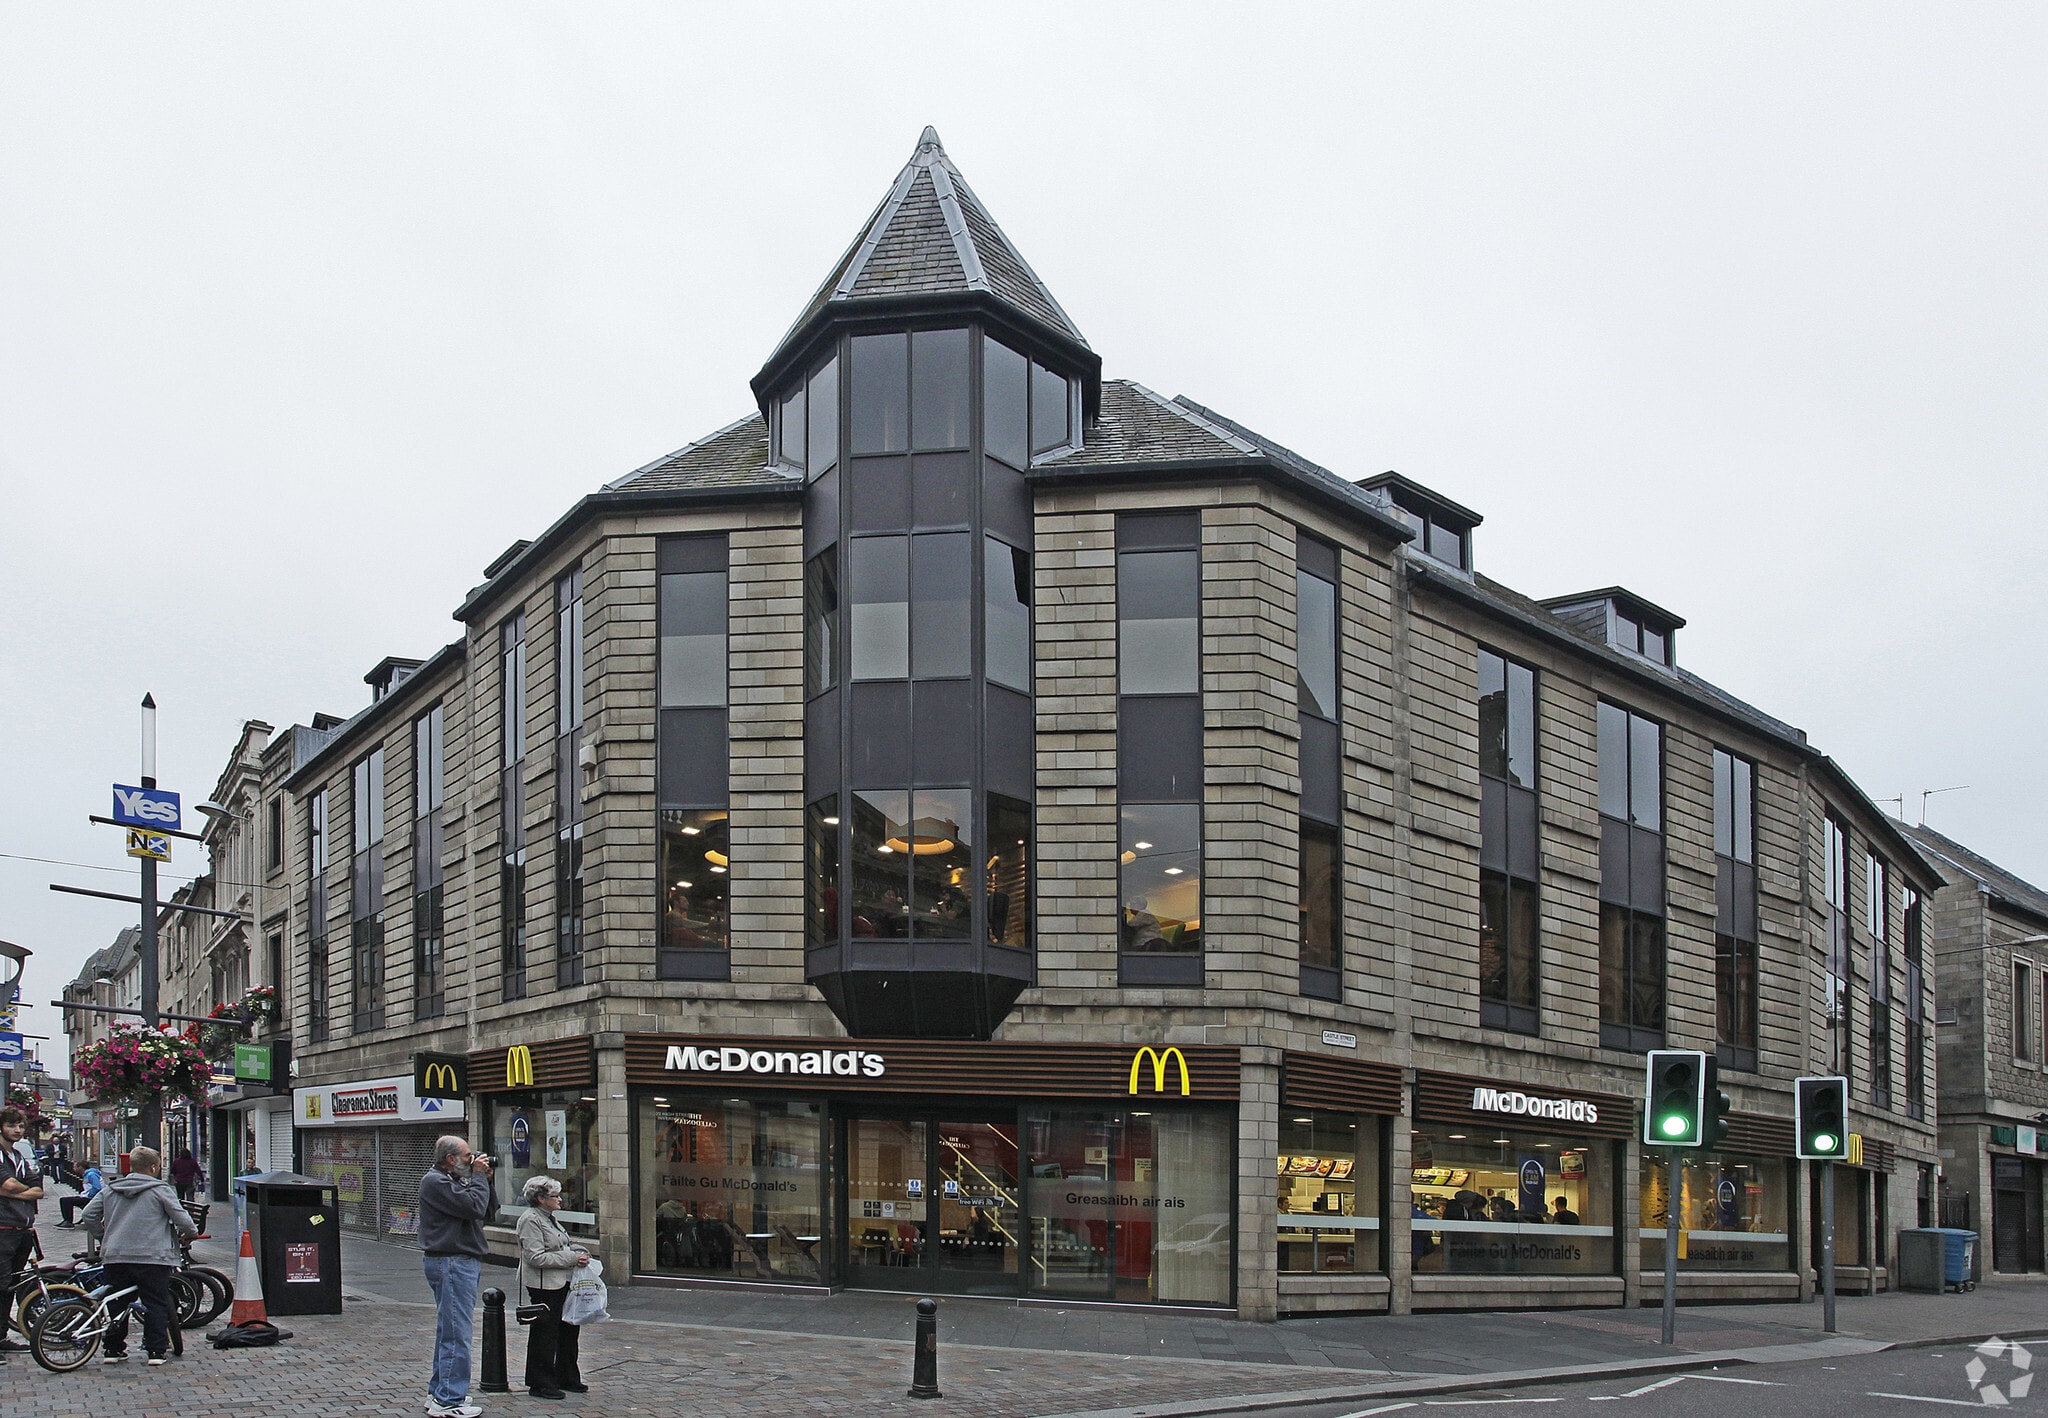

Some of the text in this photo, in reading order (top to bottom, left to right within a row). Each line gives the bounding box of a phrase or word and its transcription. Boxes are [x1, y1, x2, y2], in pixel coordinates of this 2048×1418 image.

[114, 789, 178, 822] Yes
[664, 1046, 886, 1077] McDonald's
[1472, 1087, 1598, 1124] McDonald's
[700, 1177, 718, 1188] Gu
[722, 1178, 797, 1192] McDonald's
[1066, 1193, 1185, 1208] Greasaibh air ais
[1489, 1243, 1508, 1259] Gu
[1511, 1243, 1581, 1260] McDonald's
[1688, 1246, 1754, 1260] easaibh air ais
